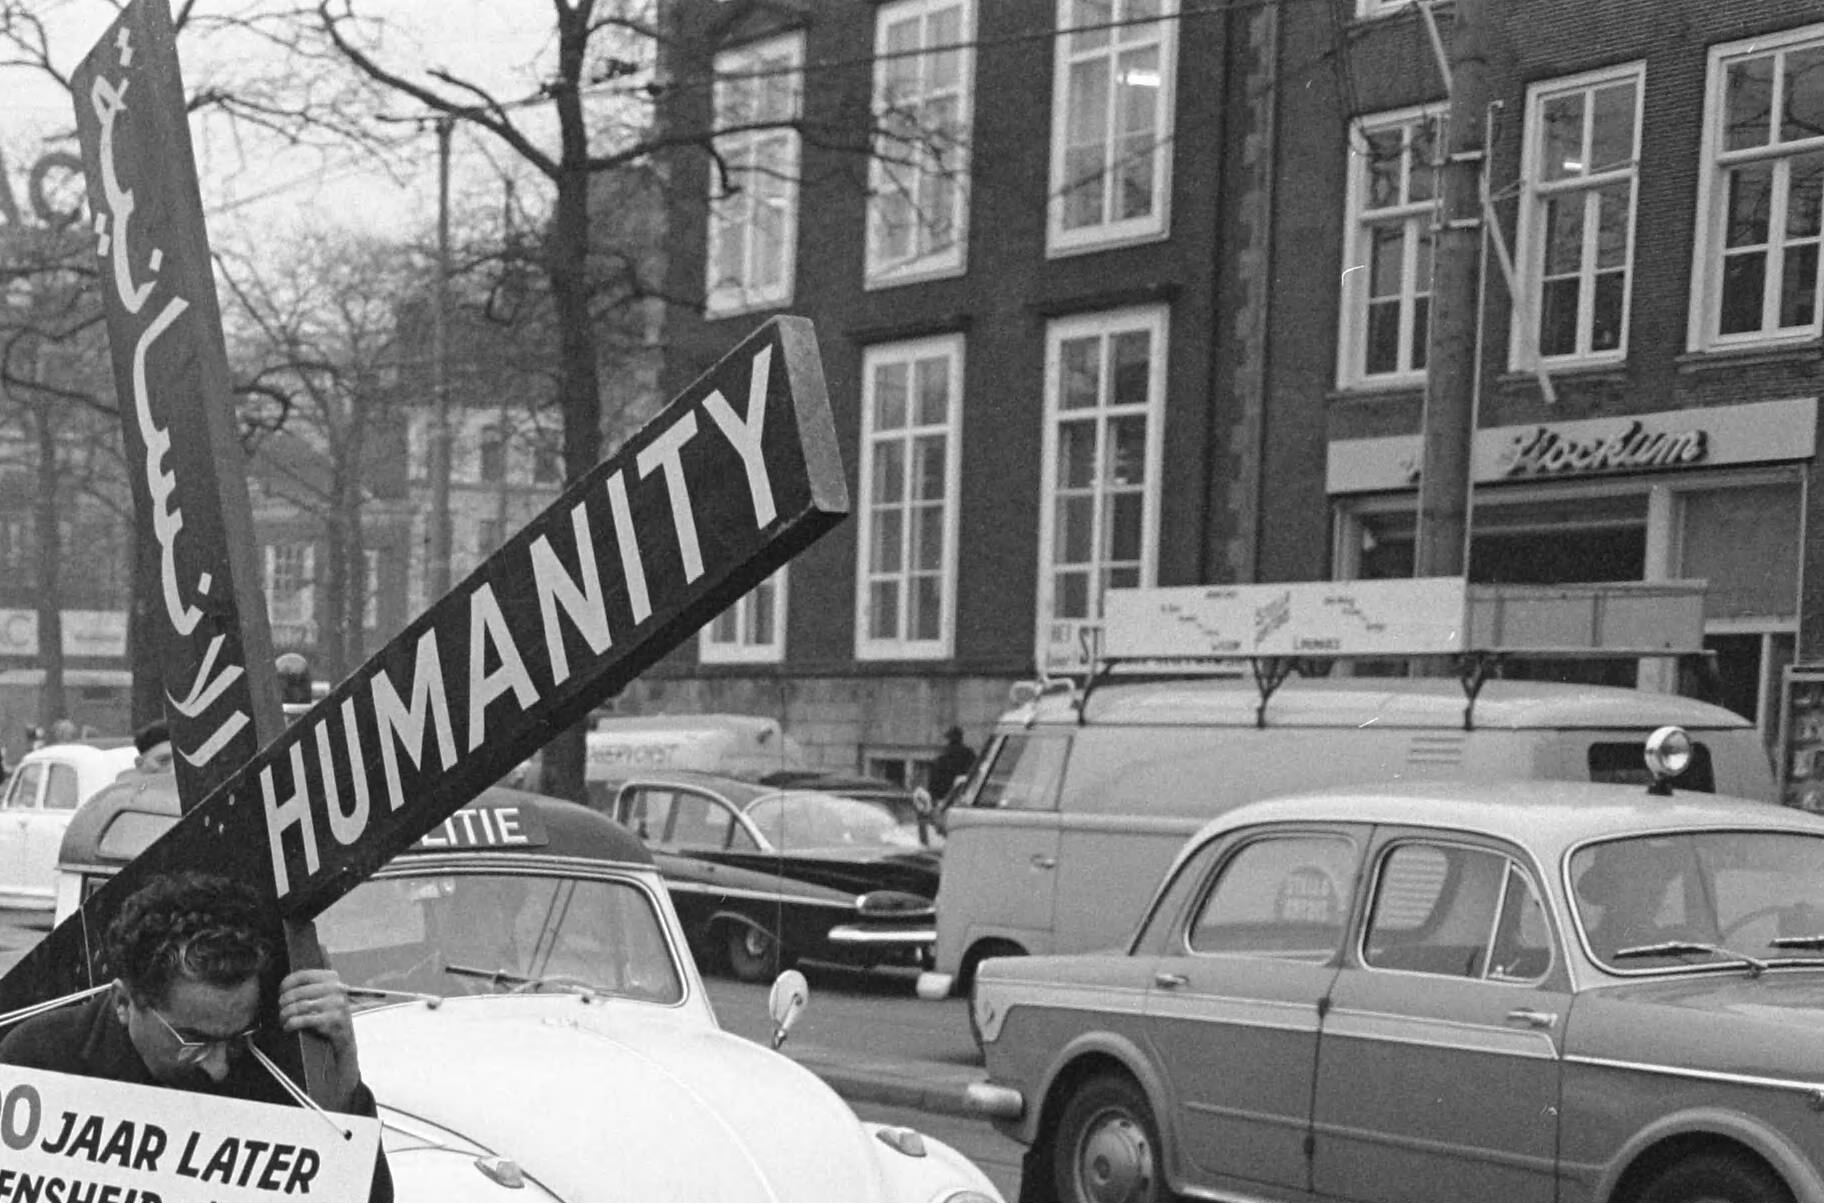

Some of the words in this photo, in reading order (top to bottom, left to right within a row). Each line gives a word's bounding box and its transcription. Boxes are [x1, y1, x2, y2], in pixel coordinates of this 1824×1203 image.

[259, 343, 778, 899] HUMANITY
[421, 807, 529, 846] LITIE
[39, 1110, 168, 1172] JAAR
[174, 1129, 321, 1195] LATER
